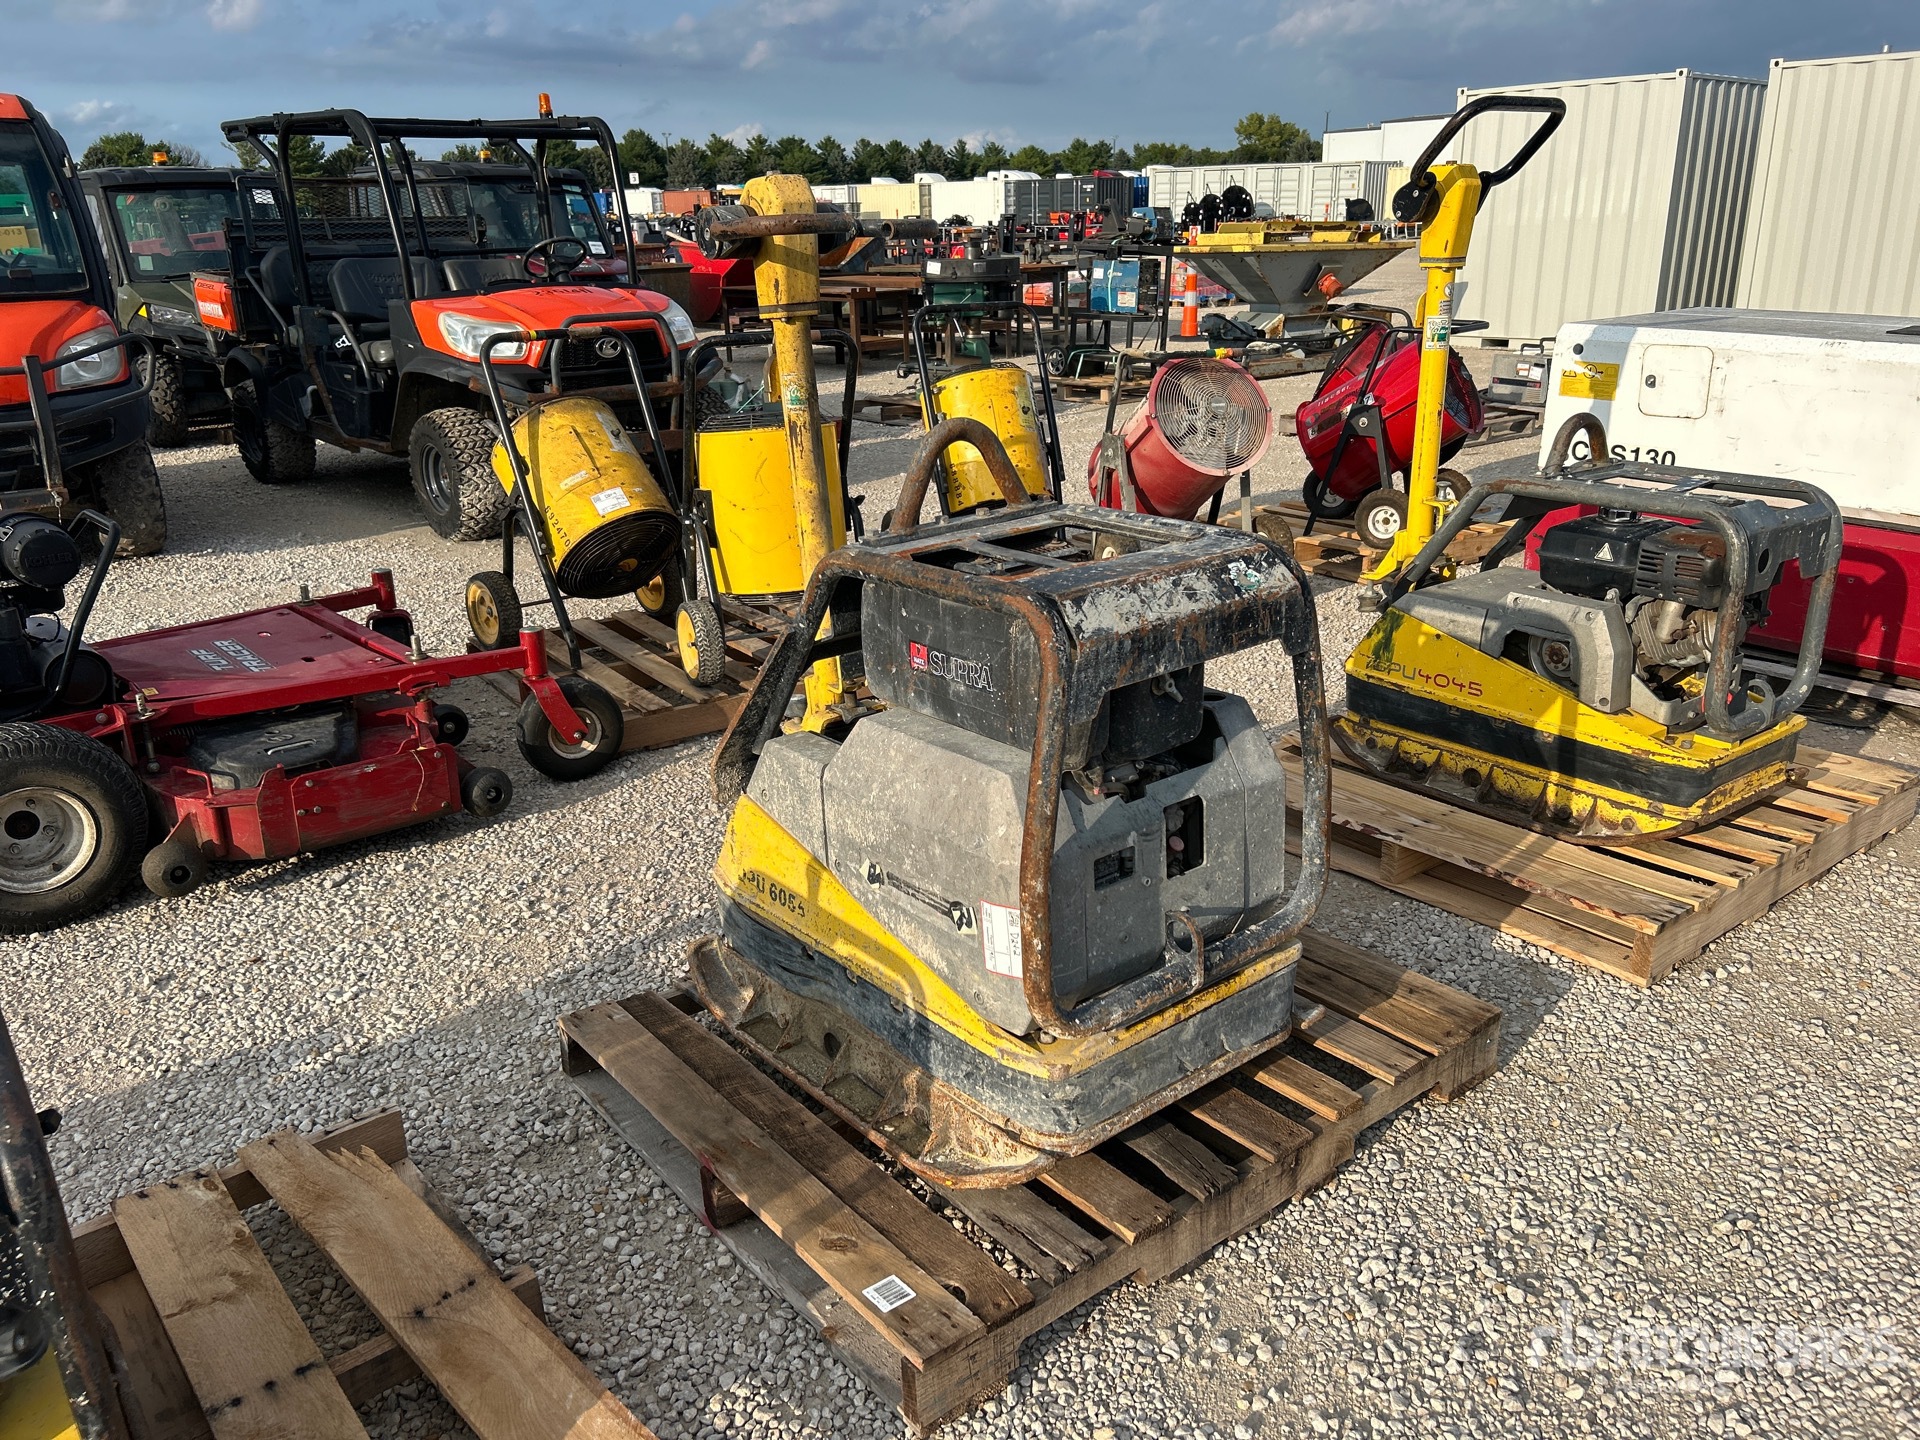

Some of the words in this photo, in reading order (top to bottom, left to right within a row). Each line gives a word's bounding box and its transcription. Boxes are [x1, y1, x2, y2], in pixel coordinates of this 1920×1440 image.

[1571, 440, 1676, 466] CS130
[191, 649, 235, 671] TURF
[213, 639, 272, 672] TRACER
[929, 650, 994, 692] SUPRA
